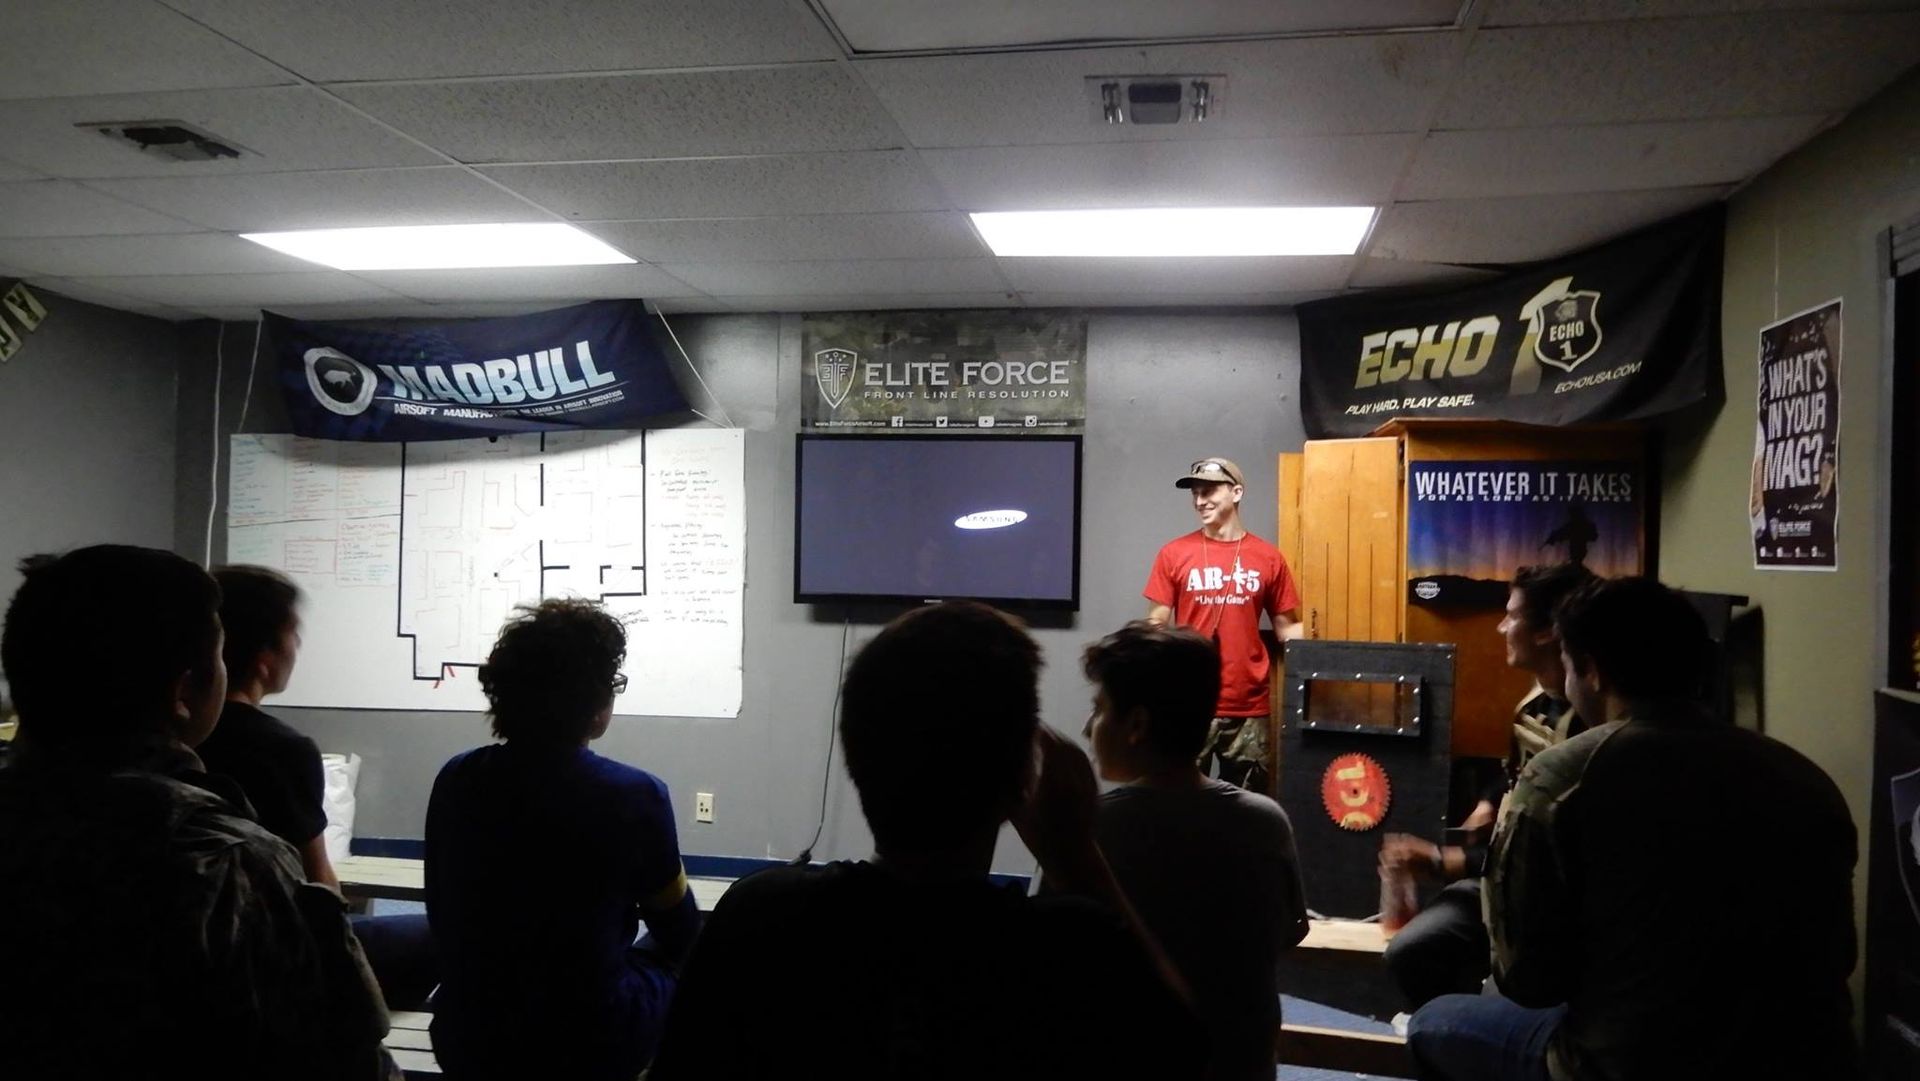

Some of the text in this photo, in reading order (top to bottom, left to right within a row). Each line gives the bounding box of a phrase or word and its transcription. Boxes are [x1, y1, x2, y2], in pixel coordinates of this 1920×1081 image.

[1549, 320, 1585, 342] ECHO
[1354, 315, 1501, 389] ECHO
[1559, 340, 1578, 361] 1
[377, 340, 616, 404] MADBULL
[864, 360, 1070, 386] ELITE FORCE
[1768, 348, 1828, 400] WHAT'S
[864, 390, 1070, 399] FRONT LINE RESOLUTION
[1345, 394, 1475, 415] PLAY HARD. PLAY SAFE.
[1767, 391, 1828, 441] IN YOUR
[1763, 433, 1825, 491] MAG?
[1415, 471, 1632, 496] WHATEVER IT TAKES
